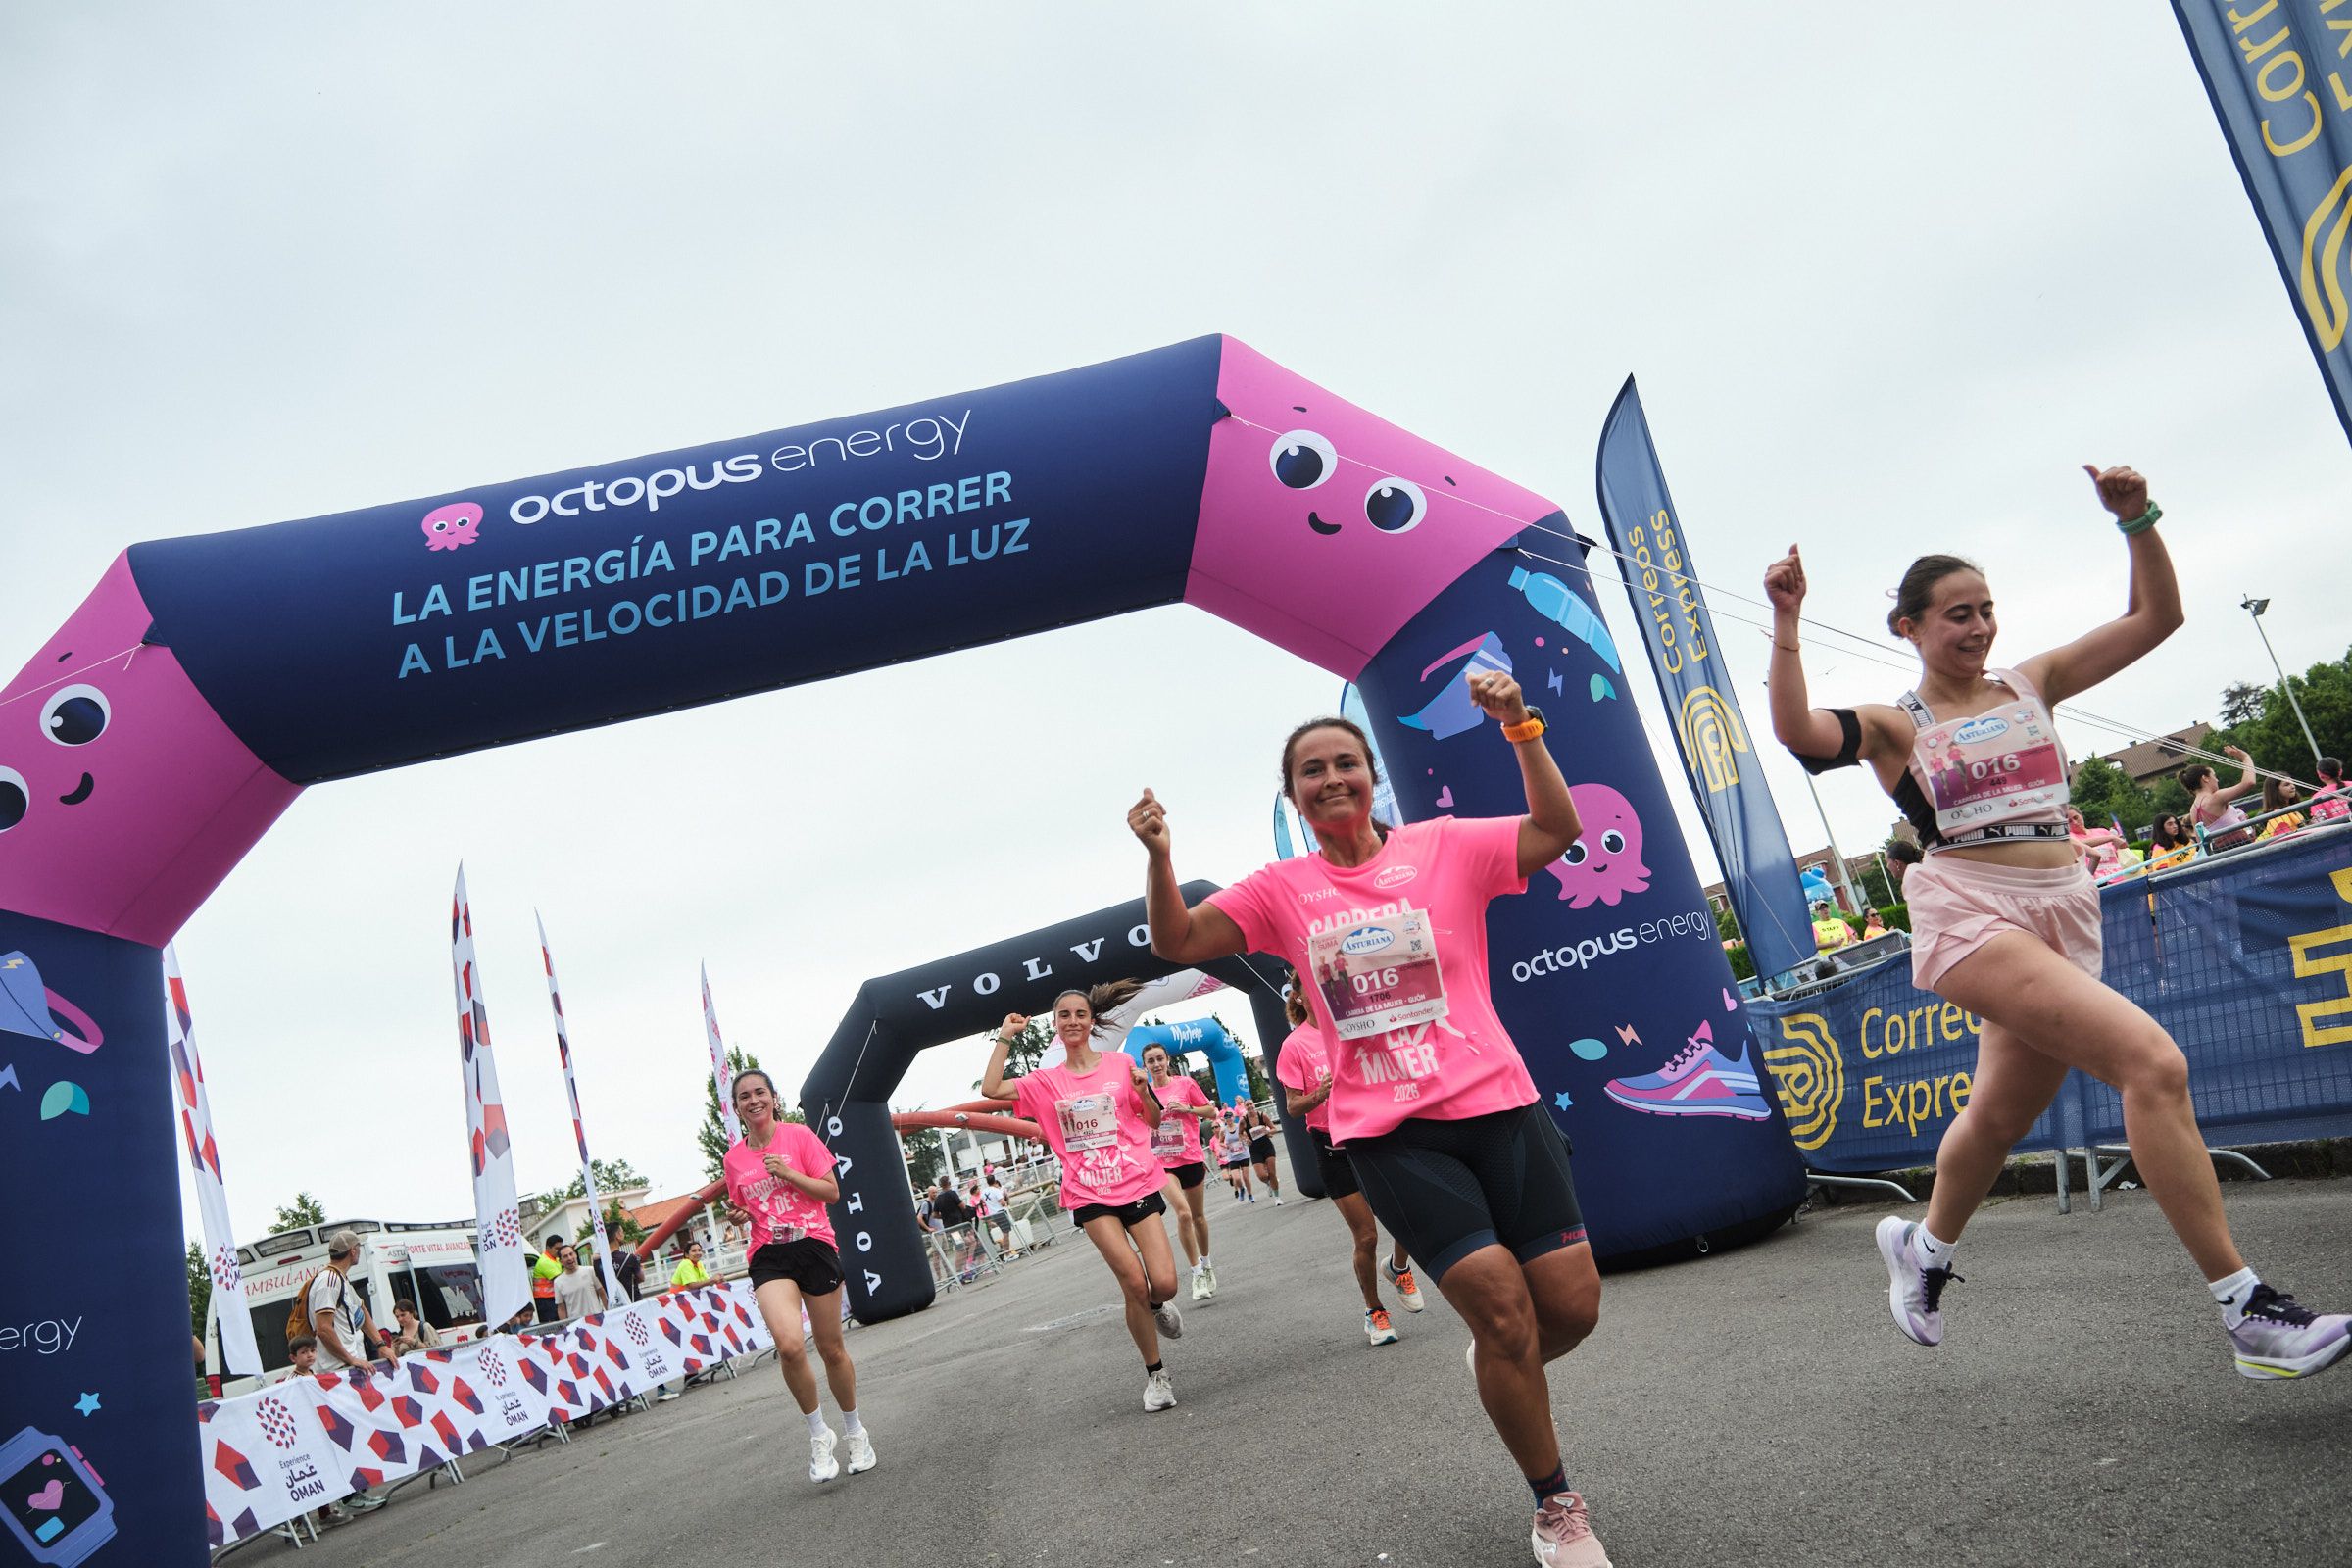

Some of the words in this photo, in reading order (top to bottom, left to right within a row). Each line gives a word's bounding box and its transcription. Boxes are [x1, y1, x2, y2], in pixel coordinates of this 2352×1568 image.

[2225, 0, 2323, 157] Corr
[509, 454, 762, 525] octopus
[771, 409, 971, 472] energy
[393, 583, 453, 626] LA
[467, 535, 676, 612] ENERGÍA
[691, 512, 815, 563] PARA
[829, 470, 1014, 538] CORRER
[1650, 509, 1708, 663] Express
[398, 643, 432, 678] A
[446, 628, 507, 670] LA
[517, 571, 790, 654] VELOCIDAD
[804, 554, 862, 597] DE
[878, 539, 933, 580] LA
[948, 517, 1032, 565] LUZ
[1628, 525, 1683, 675] Correos
[1971, 753, 2021, 780] 016
[1989, 776, 2007, 787] 449
[2002, 784, 2023, 794] MUJER
[1951, 804, 1992, 819] OHO
[2005, 825, 2035, 836] PUMA
[1345, 935, 1392, 952] ASTURIANA
[1512, 928, 1637, 982] octopus
[1639, 911, 1711, 944] energy
[917, 924, 1152, 1010] VOLVO
[1352, 967, 1399, 994] 016
[1370, 991, 1391, 1003] 1706
[1397, 1006, 1434, 1021] Santander
[1346, 1020, 1375, 1033] OYSHO
[1359, 1042, 1440, 1085] MUJER
[1394, 1083, 1420, 1102] 2026
[1076, 1118, 1098, 1130] 016
[743, 1175, 792, 1200] CARRER
[1079, 1166, 1123, 1187] MUJER
[827, 1116, 882, 1297] VOLVO
[648, 1364, 668, 1379] OMAN
[506, 1410, 529, 1426] OMAN
[278, 1453, 311, 1469] Experience
[290, 1479, 325, 1502] OMAN
